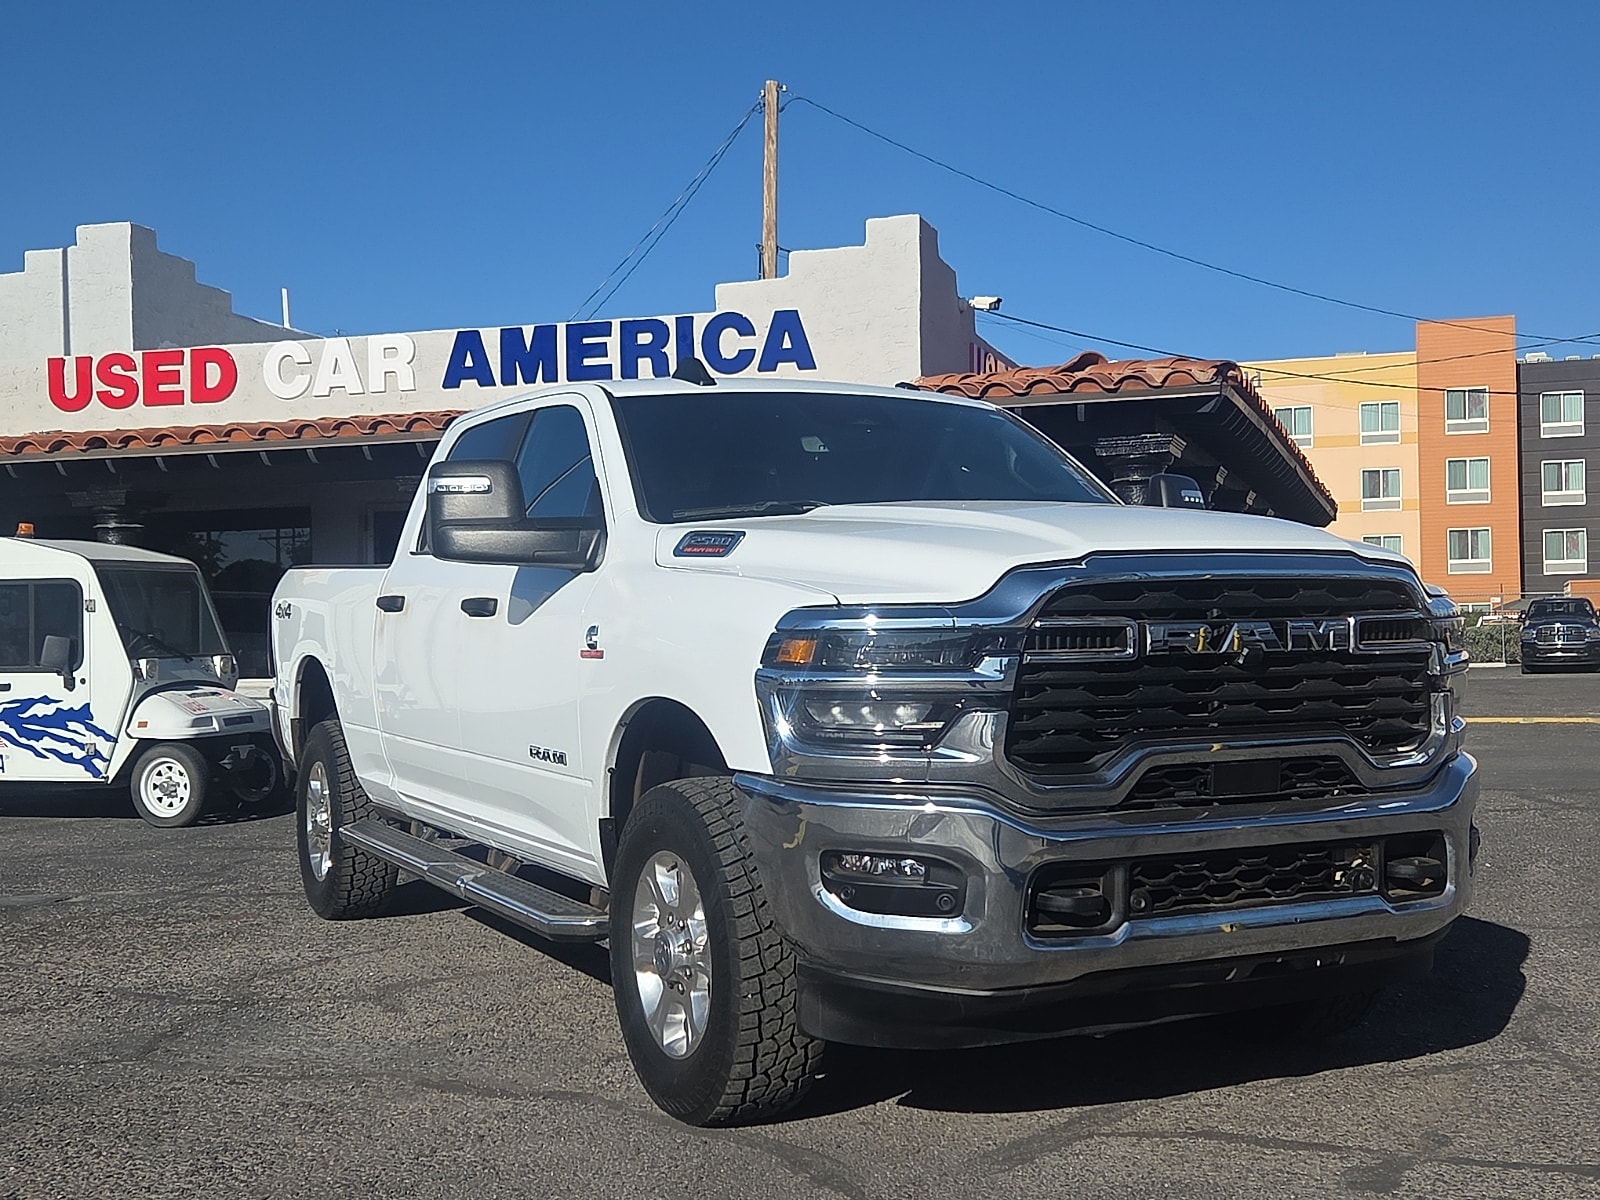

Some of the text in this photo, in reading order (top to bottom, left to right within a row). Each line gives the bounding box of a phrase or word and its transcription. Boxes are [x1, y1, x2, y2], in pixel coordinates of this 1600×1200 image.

[47, 310, 817, 412] USED CAR AMERICA
[688, 536, 732, 546] 2500
[1146, 619, 1350, 655] RAM
[529, 744, 567, 766] RAM
